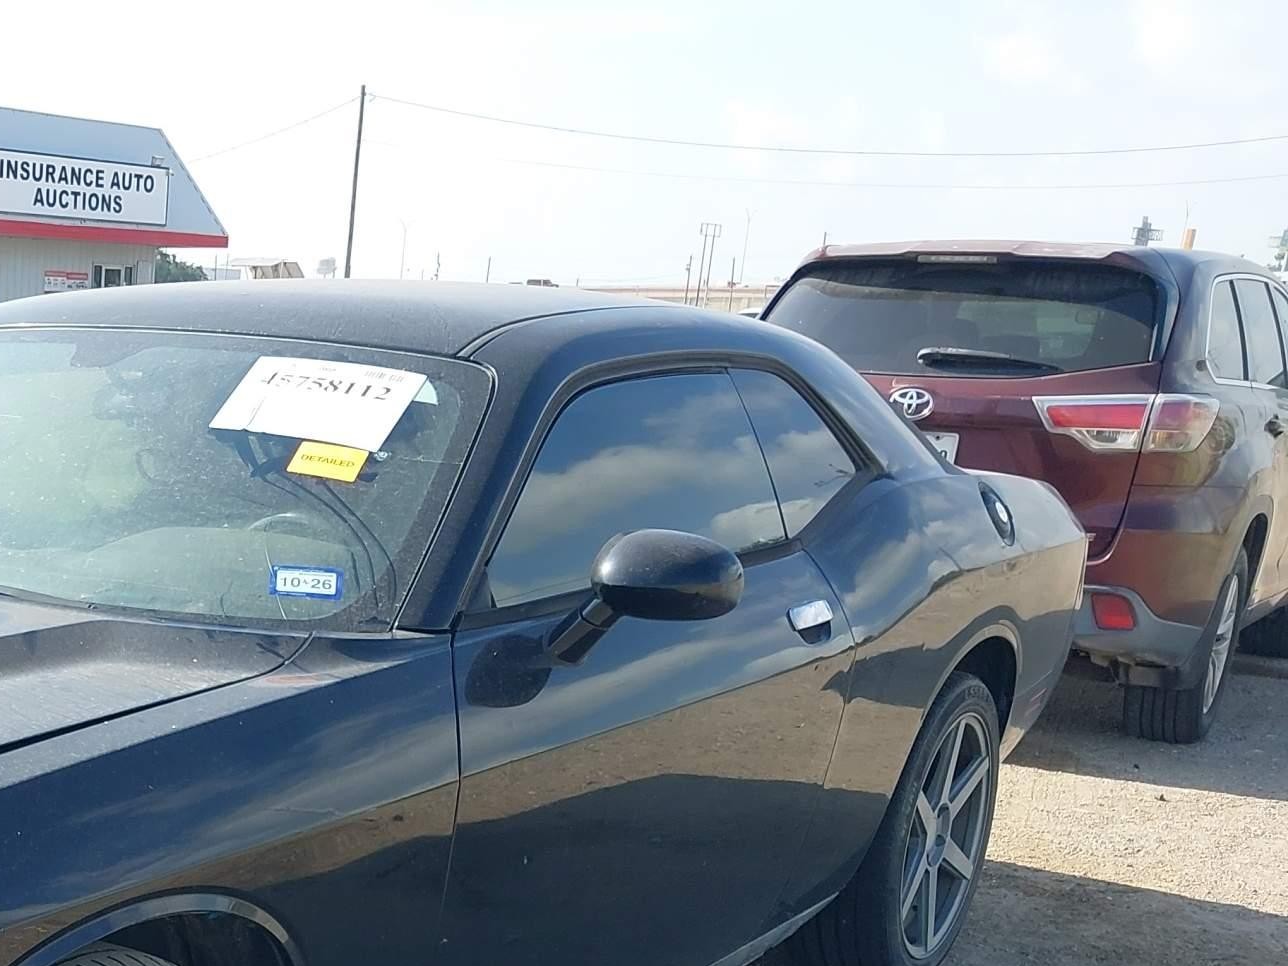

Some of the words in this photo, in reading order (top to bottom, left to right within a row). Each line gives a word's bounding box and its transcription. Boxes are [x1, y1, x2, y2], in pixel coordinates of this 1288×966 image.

[0, 159, 105, 188] INSURANCE
[110, 171, 154, 193] AUTO
[33, 187, 123, 214] AUCTIONS
[261, 371, 392, 401] 45758112
[300, 453, 356, 468] DETAILED
